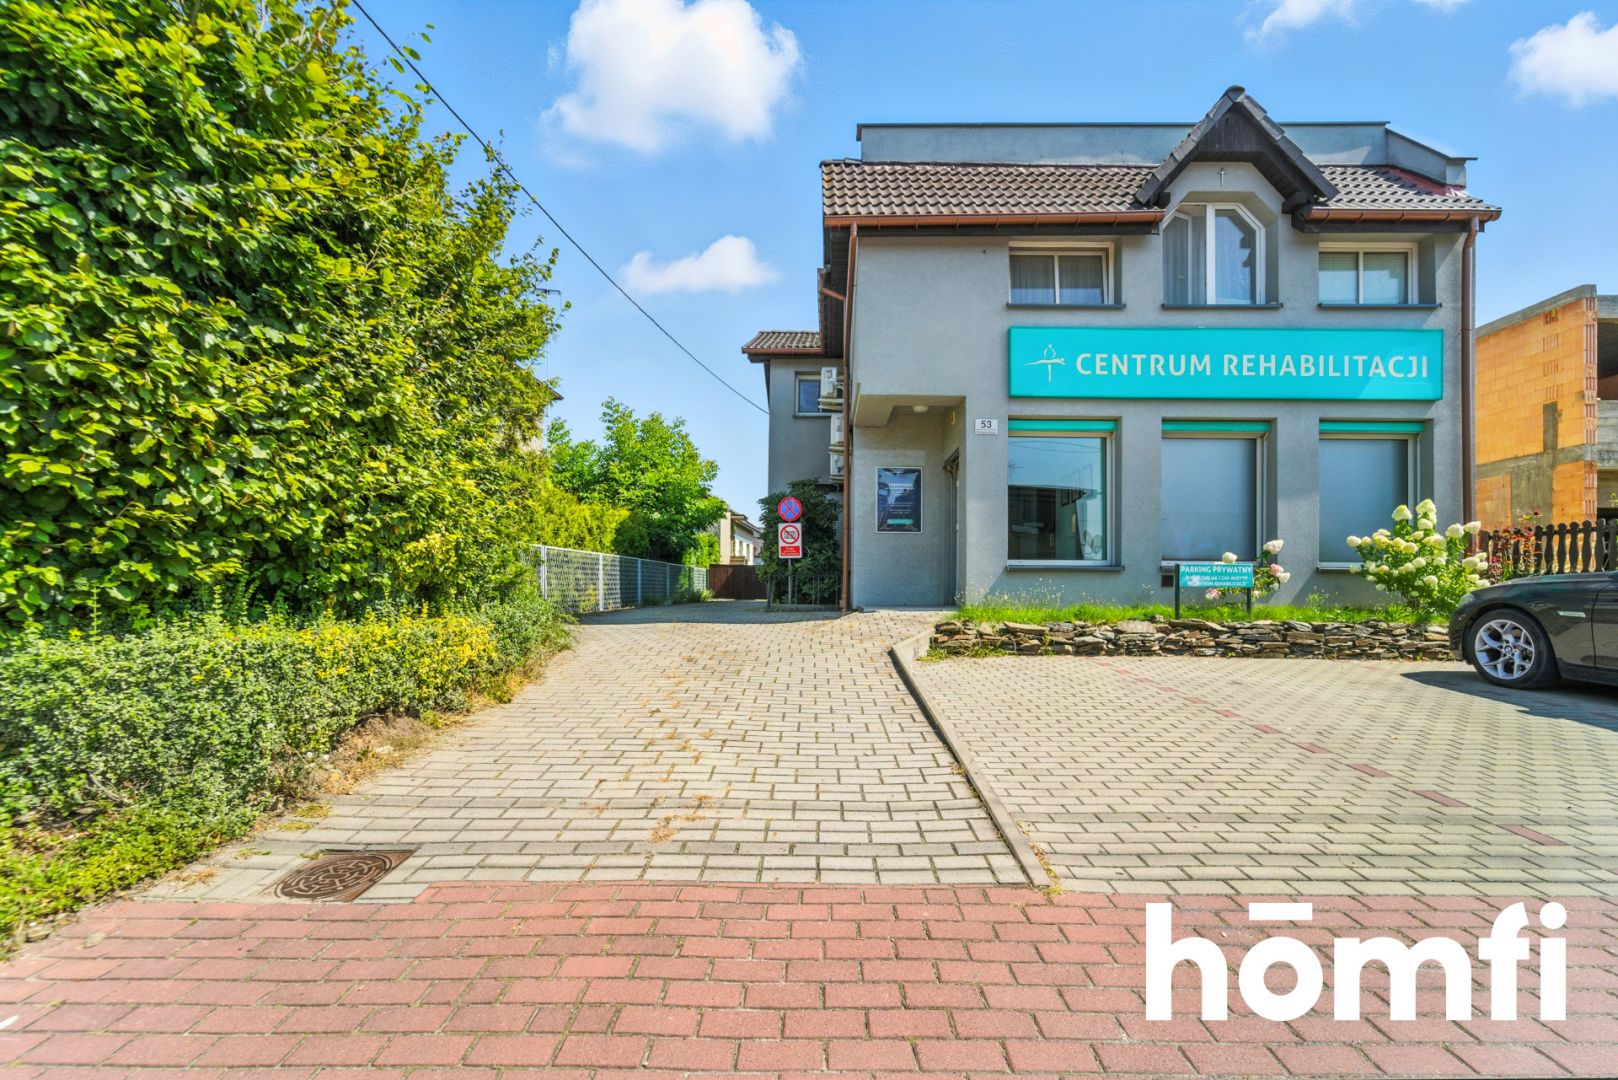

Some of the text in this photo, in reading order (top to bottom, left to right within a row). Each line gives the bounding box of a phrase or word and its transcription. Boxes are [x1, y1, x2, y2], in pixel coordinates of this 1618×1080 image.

[1076, 352, 1429, 379] CENTRUM REHABILITACJI
[981, 420, 992, 429] 53
